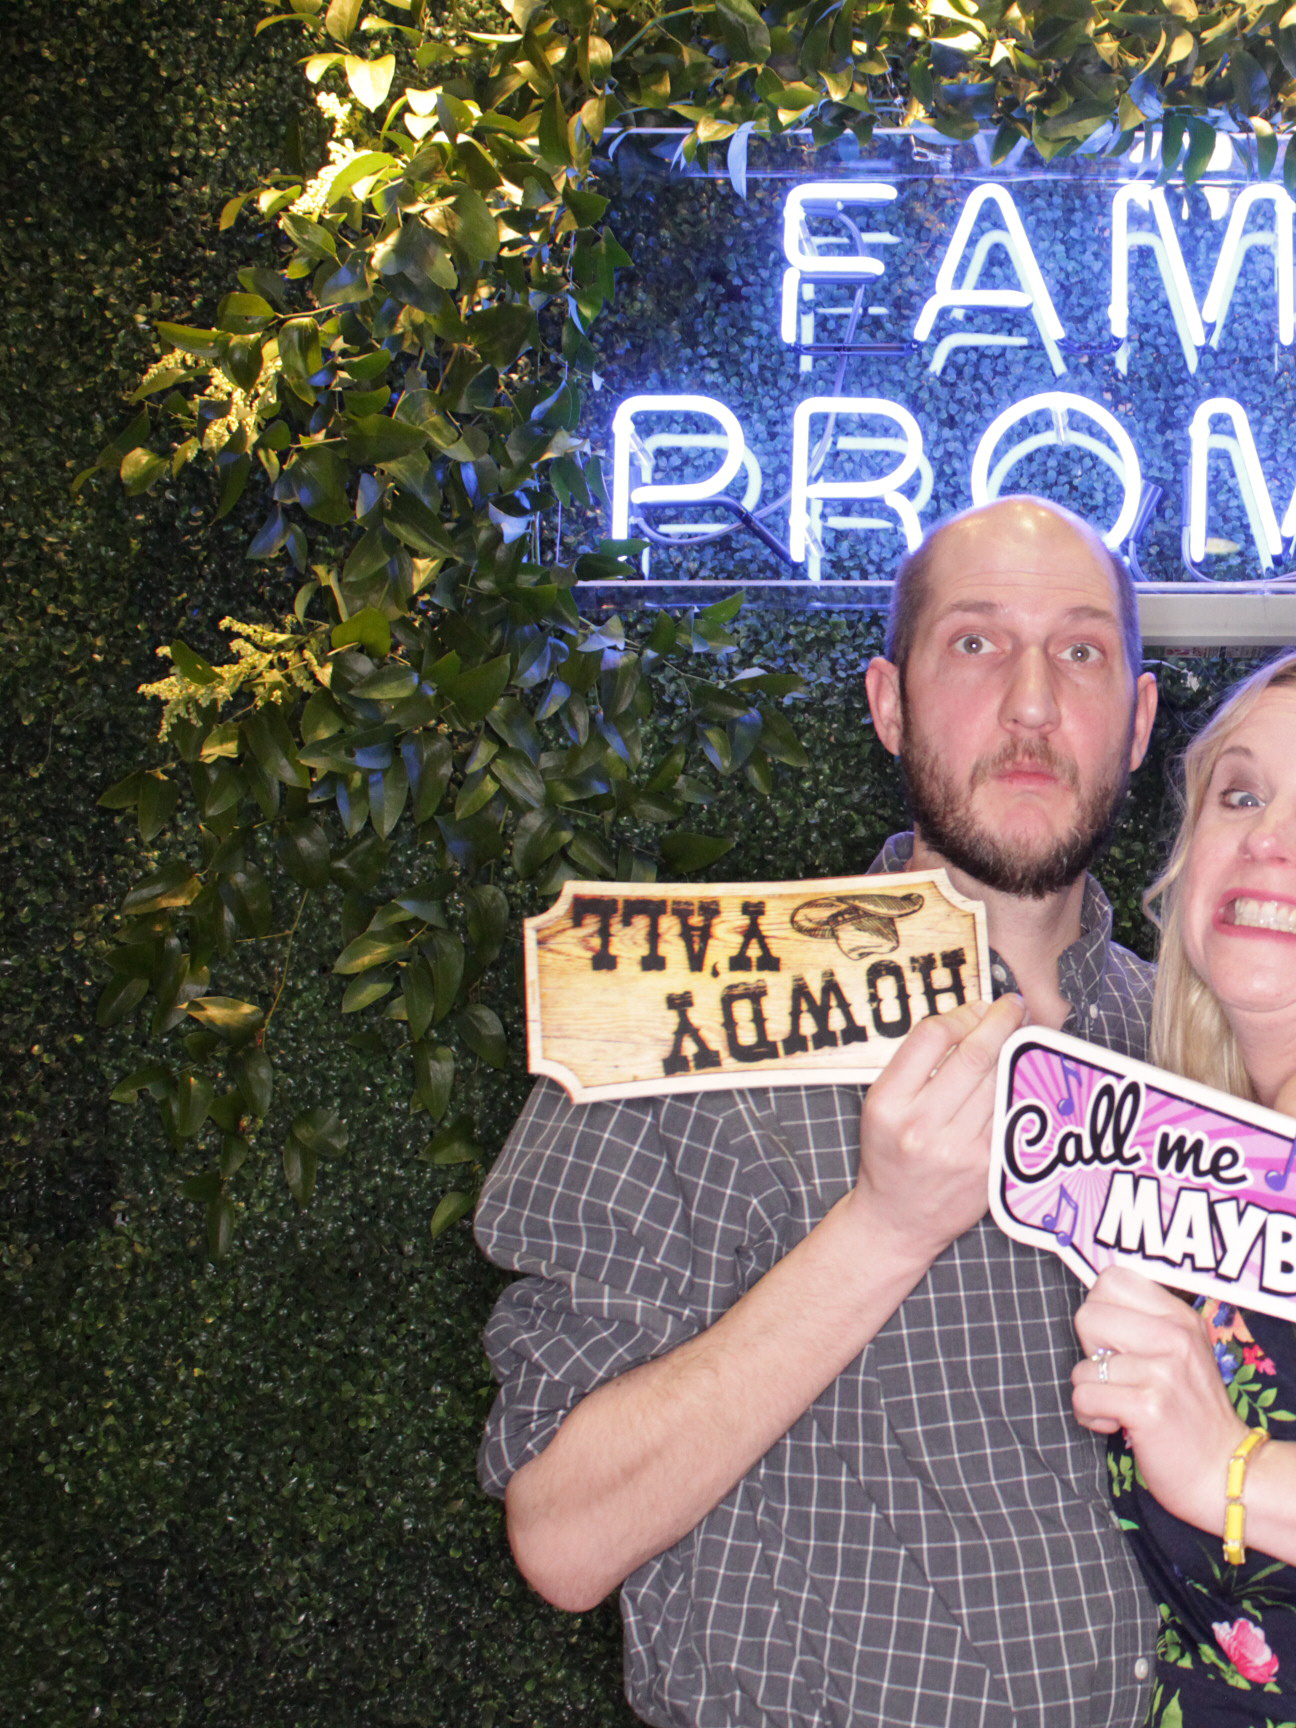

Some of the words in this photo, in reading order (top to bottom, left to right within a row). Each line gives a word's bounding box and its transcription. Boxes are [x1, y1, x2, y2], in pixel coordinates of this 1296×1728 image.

[572, 897, 781, 978] Y'ALL
[662, 947, 966, 1075] HOWDY
[1004, 1081, 1144, 1184] Call
[1157, 1129, 1248, 1185] me
